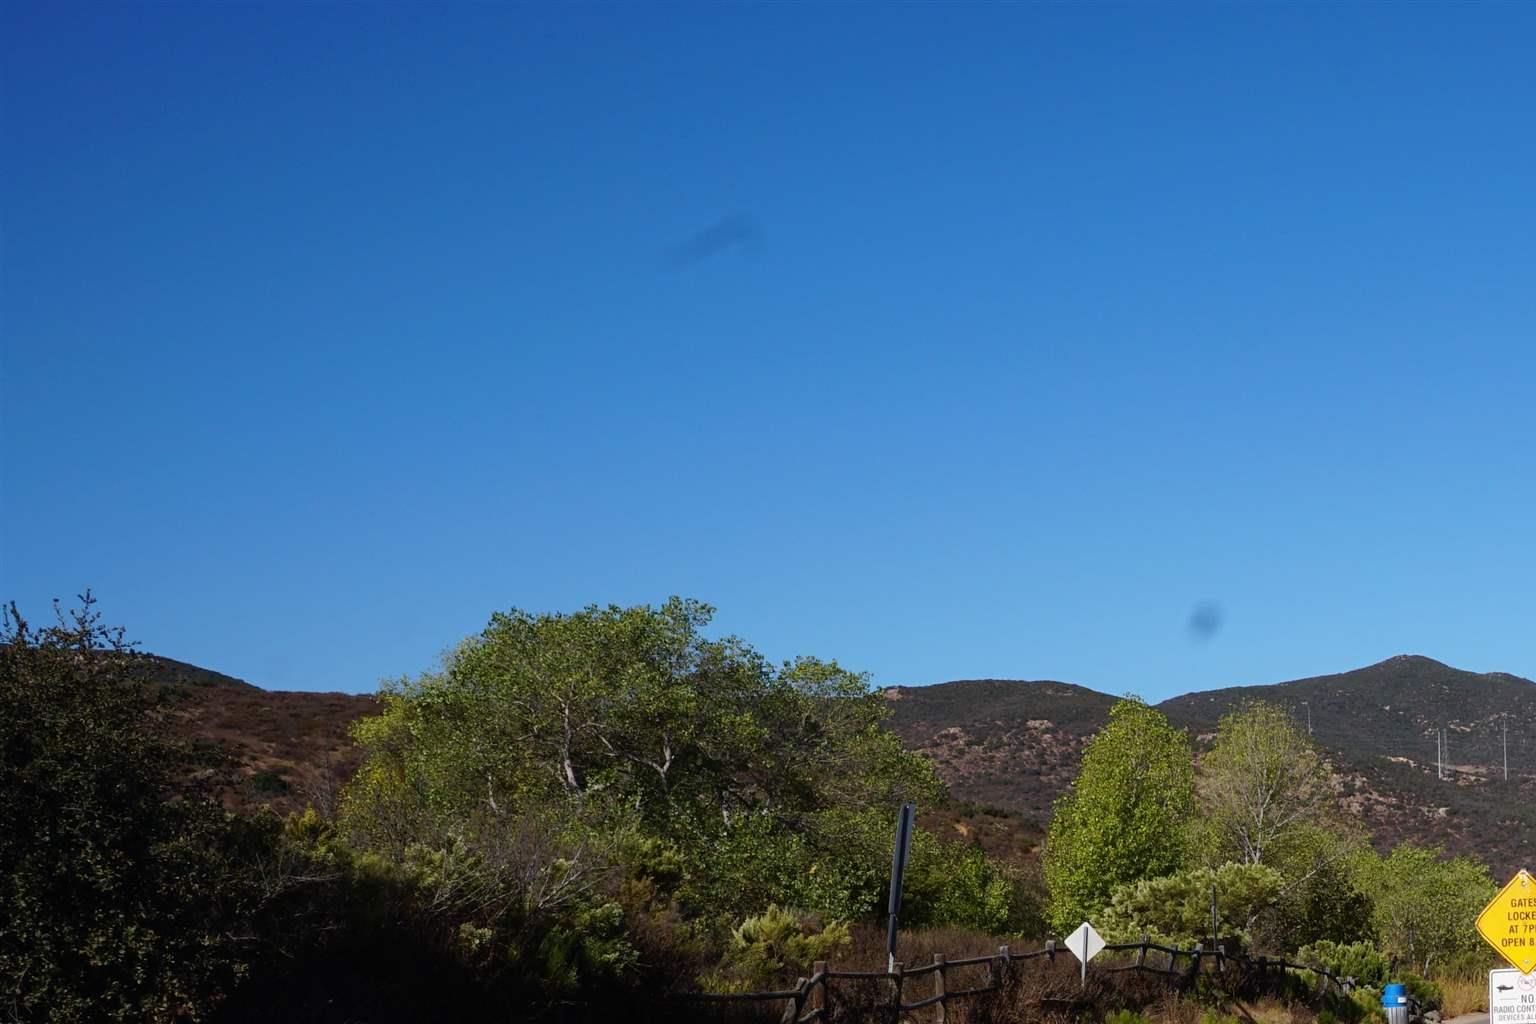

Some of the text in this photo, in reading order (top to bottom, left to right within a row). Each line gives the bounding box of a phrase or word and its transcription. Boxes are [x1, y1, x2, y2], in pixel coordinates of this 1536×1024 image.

[1509, 925, 1518, 934] AT
[1501, 937, 1526, 947] OPEN
[1521, 994, 1534, 1003] NO
[1494, 1005, 1515, 1013] RADIO
[1498, 1013, 1525, 1021] DEVICES
